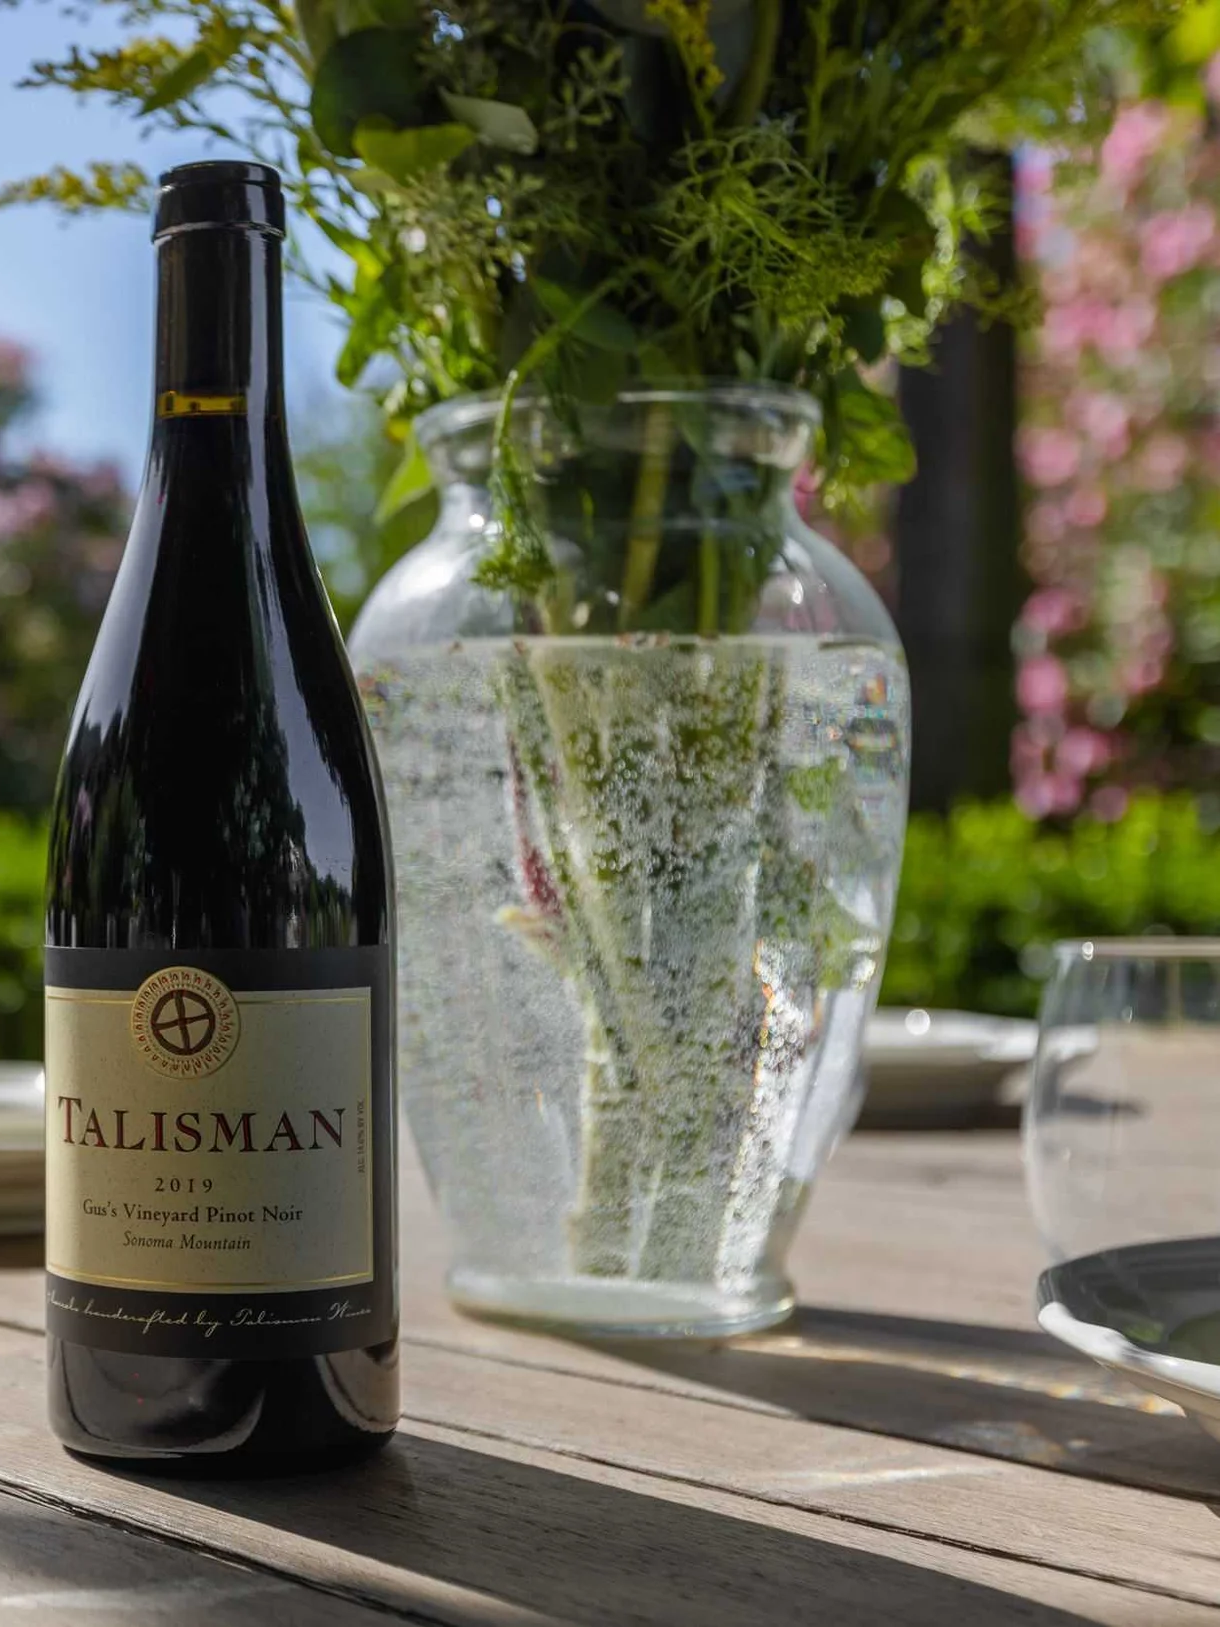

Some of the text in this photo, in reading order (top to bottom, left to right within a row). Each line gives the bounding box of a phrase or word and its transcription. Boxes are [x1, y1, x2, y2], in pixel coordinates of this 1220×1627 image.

[58, 1096, 347, 1153] TALISMAN
[82, 1198, 304, 1227] Gus's Vineyard Pinot Noir
[123, 1231, 252, 1250] Sonoma Mountain
[83, 1298, 189, 1335] handcrafted
[193, 1309, 223, 1337] by
[229, 1307, 322, 1327] Talisman
